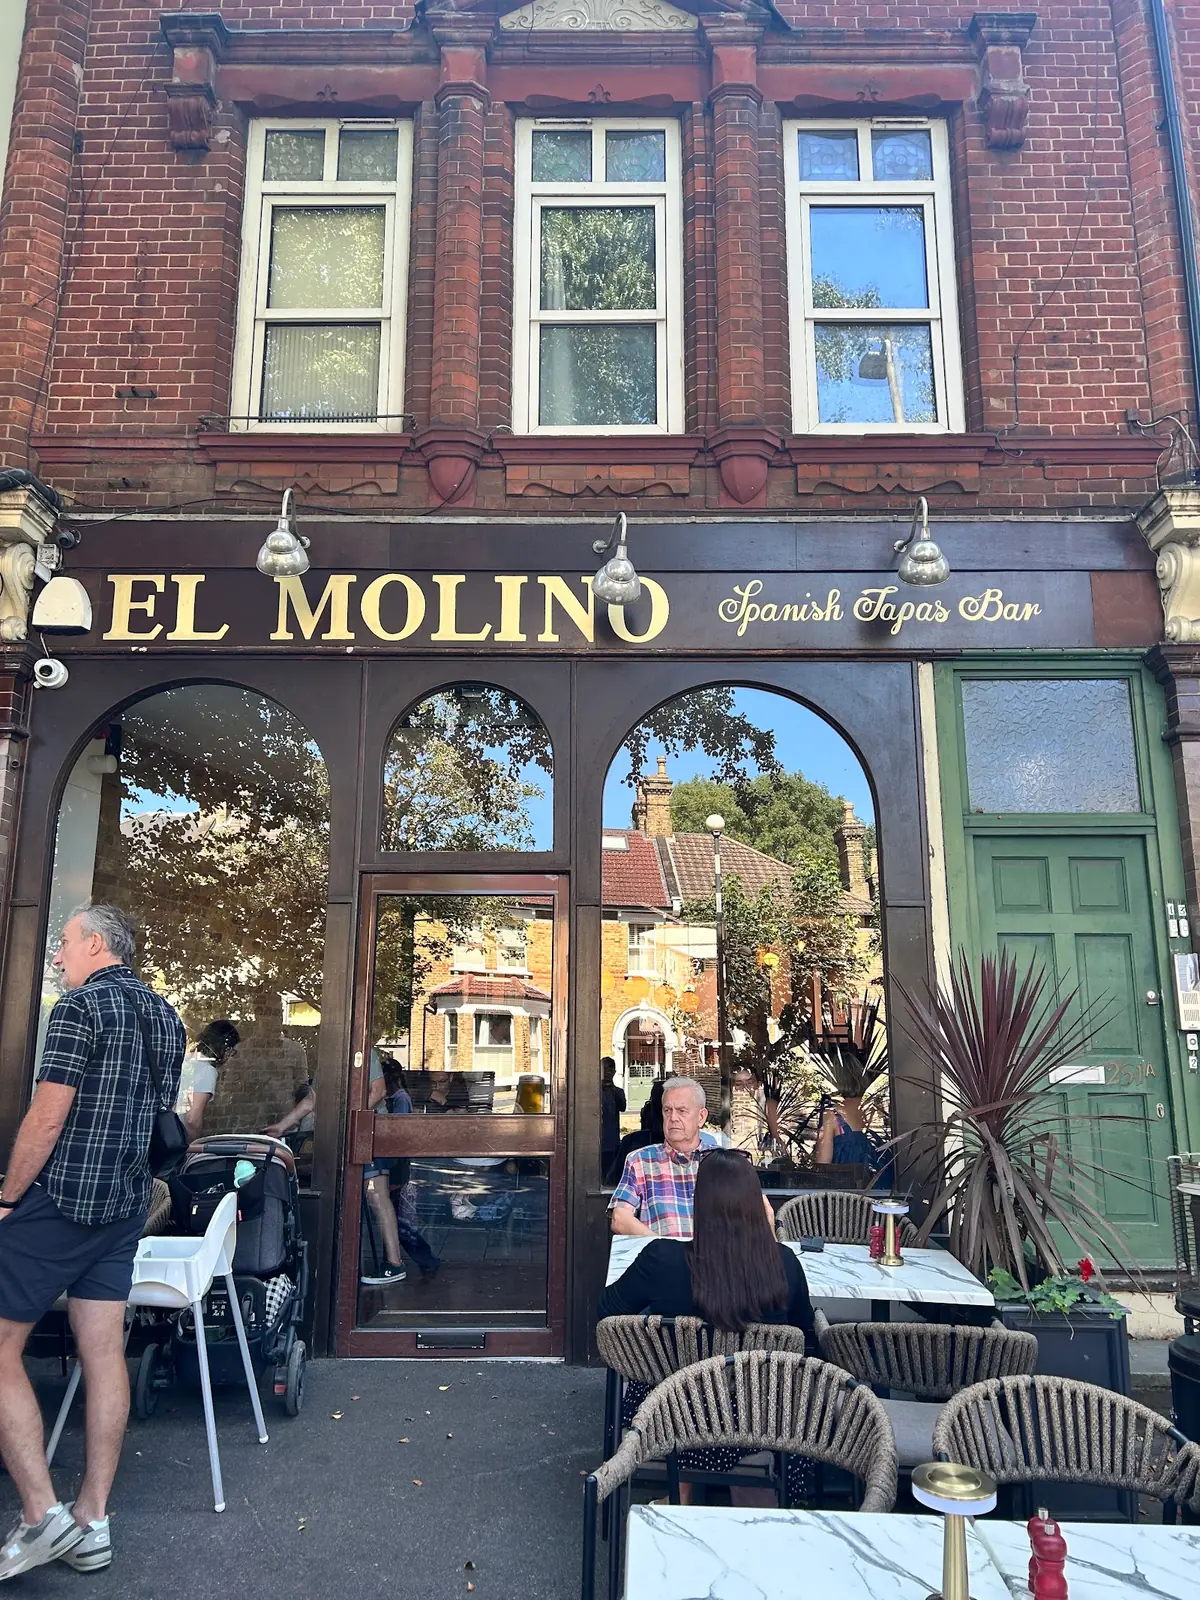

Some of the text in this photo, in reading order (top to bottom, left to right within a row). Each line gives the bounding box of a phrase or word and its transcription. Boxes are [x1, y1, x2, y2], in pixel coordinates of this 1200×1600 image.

[104, 573, 670, 643] EL MOLINO
[718, 579, 1042, 637] Spanish Tapas Bar
